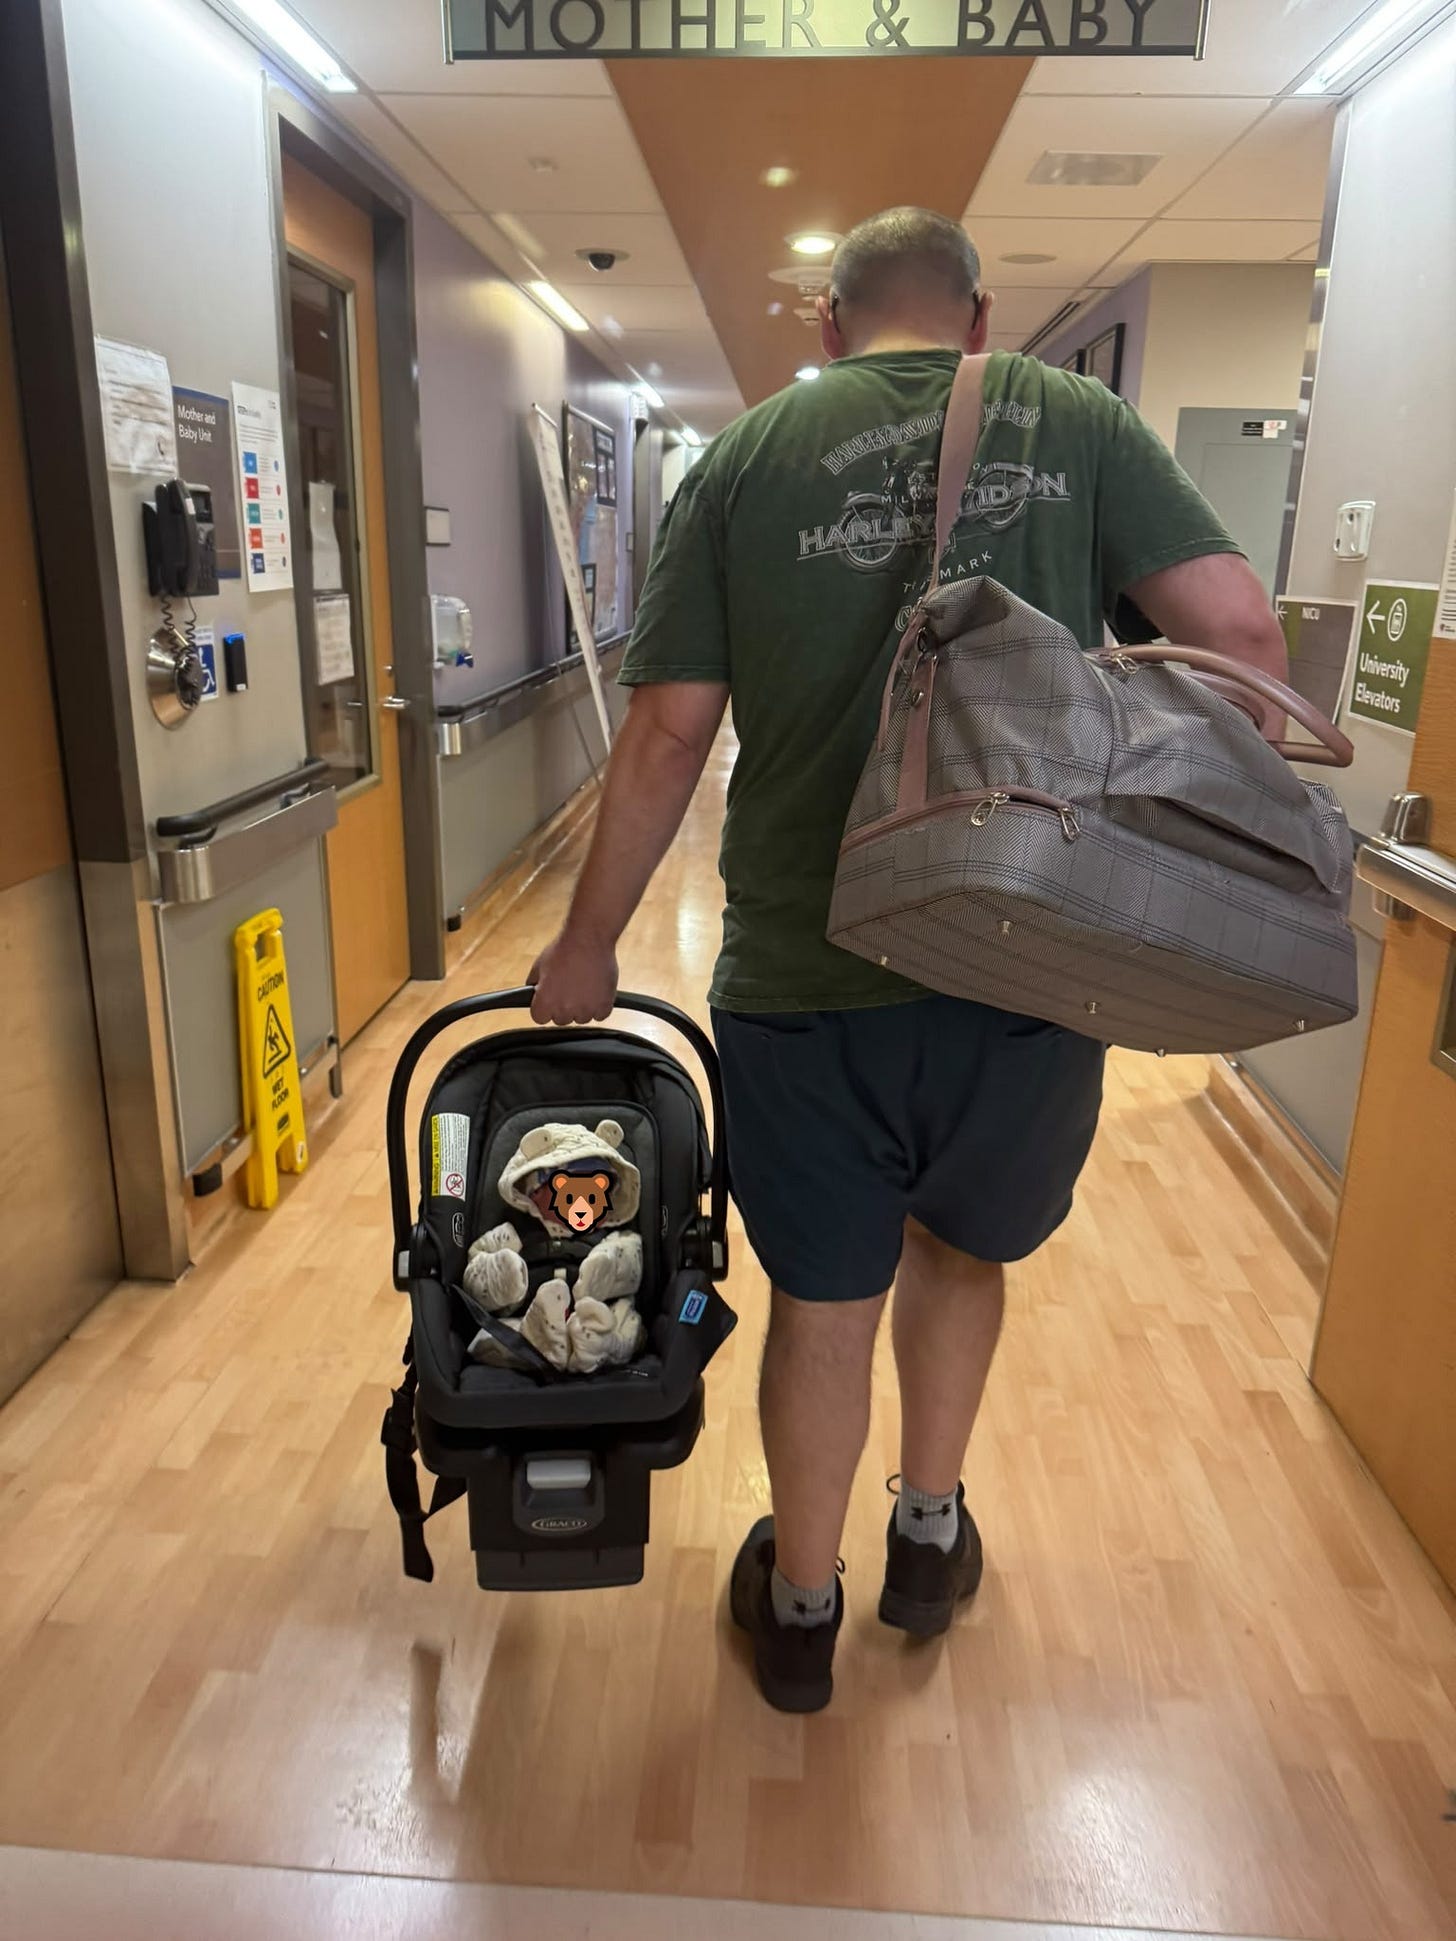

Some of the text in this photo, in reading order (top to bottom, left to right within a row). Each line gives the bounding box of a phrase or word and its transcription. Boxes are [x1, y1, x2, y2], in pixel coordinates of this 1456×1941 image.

[485, 0, 1150, 50] MOTHER & BABY
[178, 405, 216, 425] Mother and
[179, 424, 212, 443] Baby Unit
[1359, 652, 1410, 688] University
[1354, 682, 1401, 713] Elevators
[257, 971, 285, 1002] CAUTION
[272, 1077, 284, 1095] WET
[272, 1088, 290, 1111] FLOOR
